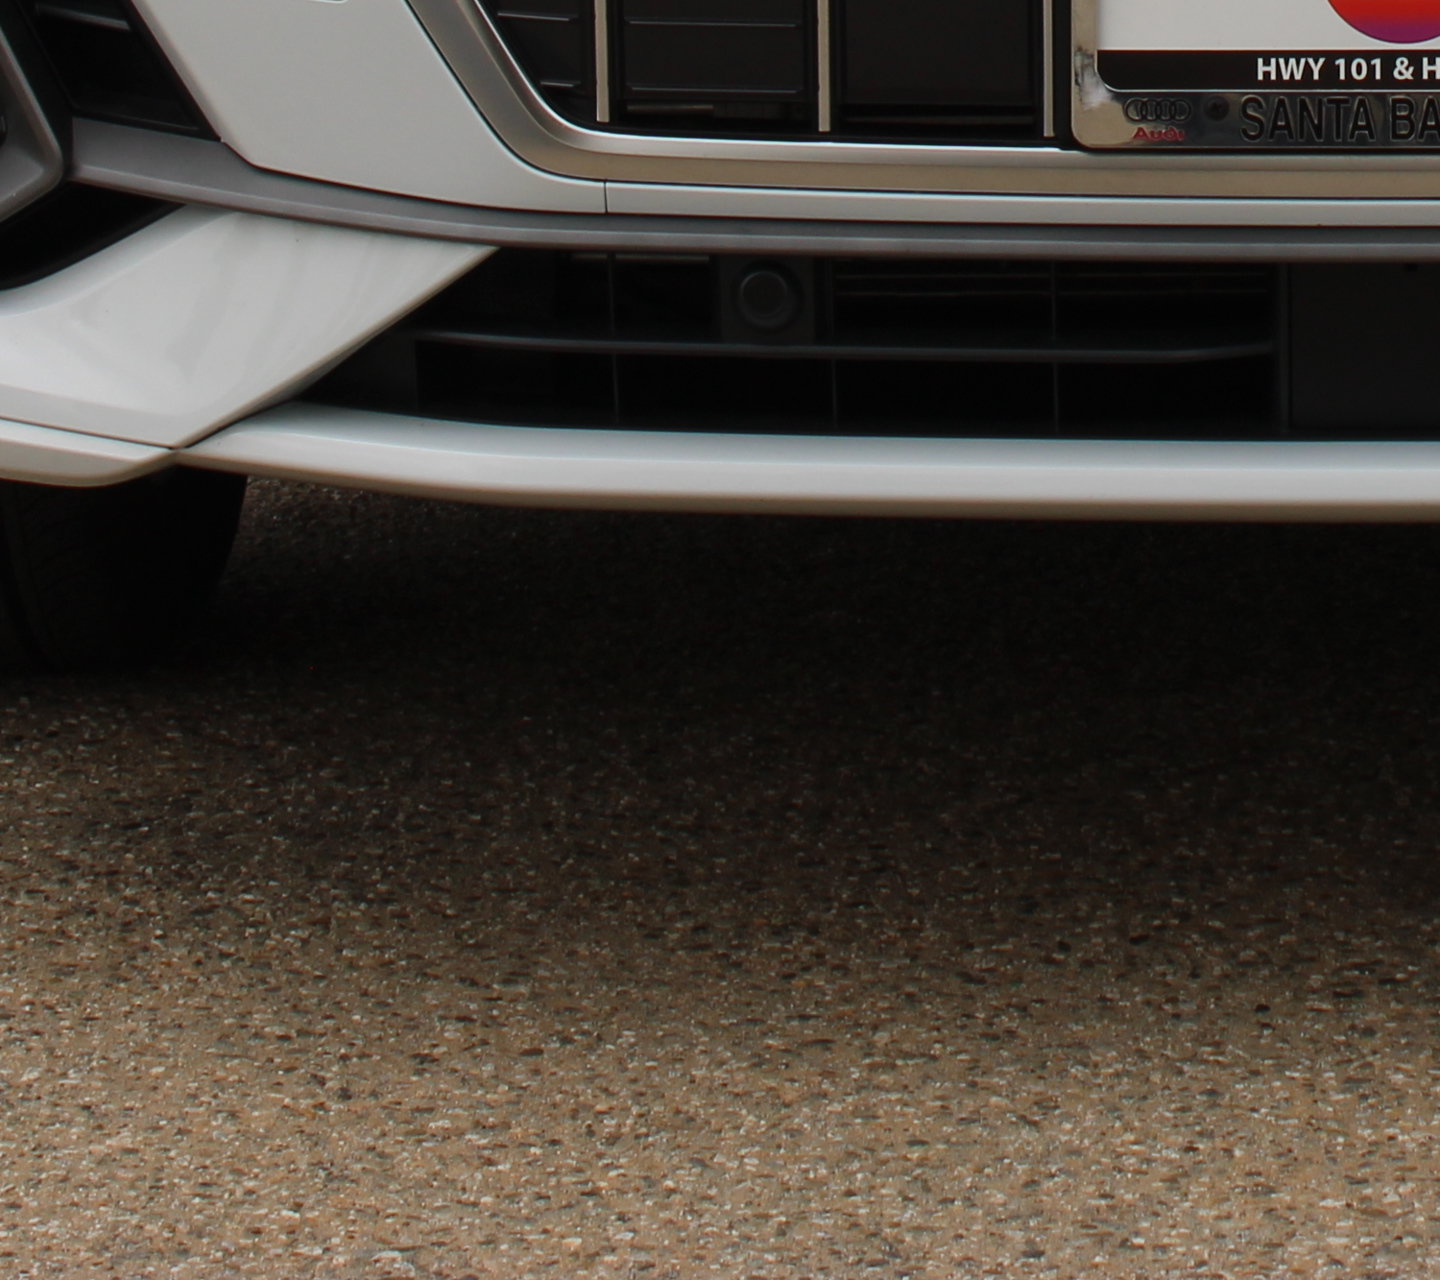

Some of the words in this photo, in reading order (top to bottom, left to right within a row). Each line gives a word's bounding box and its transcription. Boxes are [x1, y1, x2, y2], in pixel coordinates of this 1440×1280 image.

[1256, 57, 1326, 81] HWY
[1334, 57, 1382, 81] 101
[1393, 57, 1415, 81] &
[1240, 95, 1377, 141] SANTA
[1132, 126, 1187, 140] Audi
